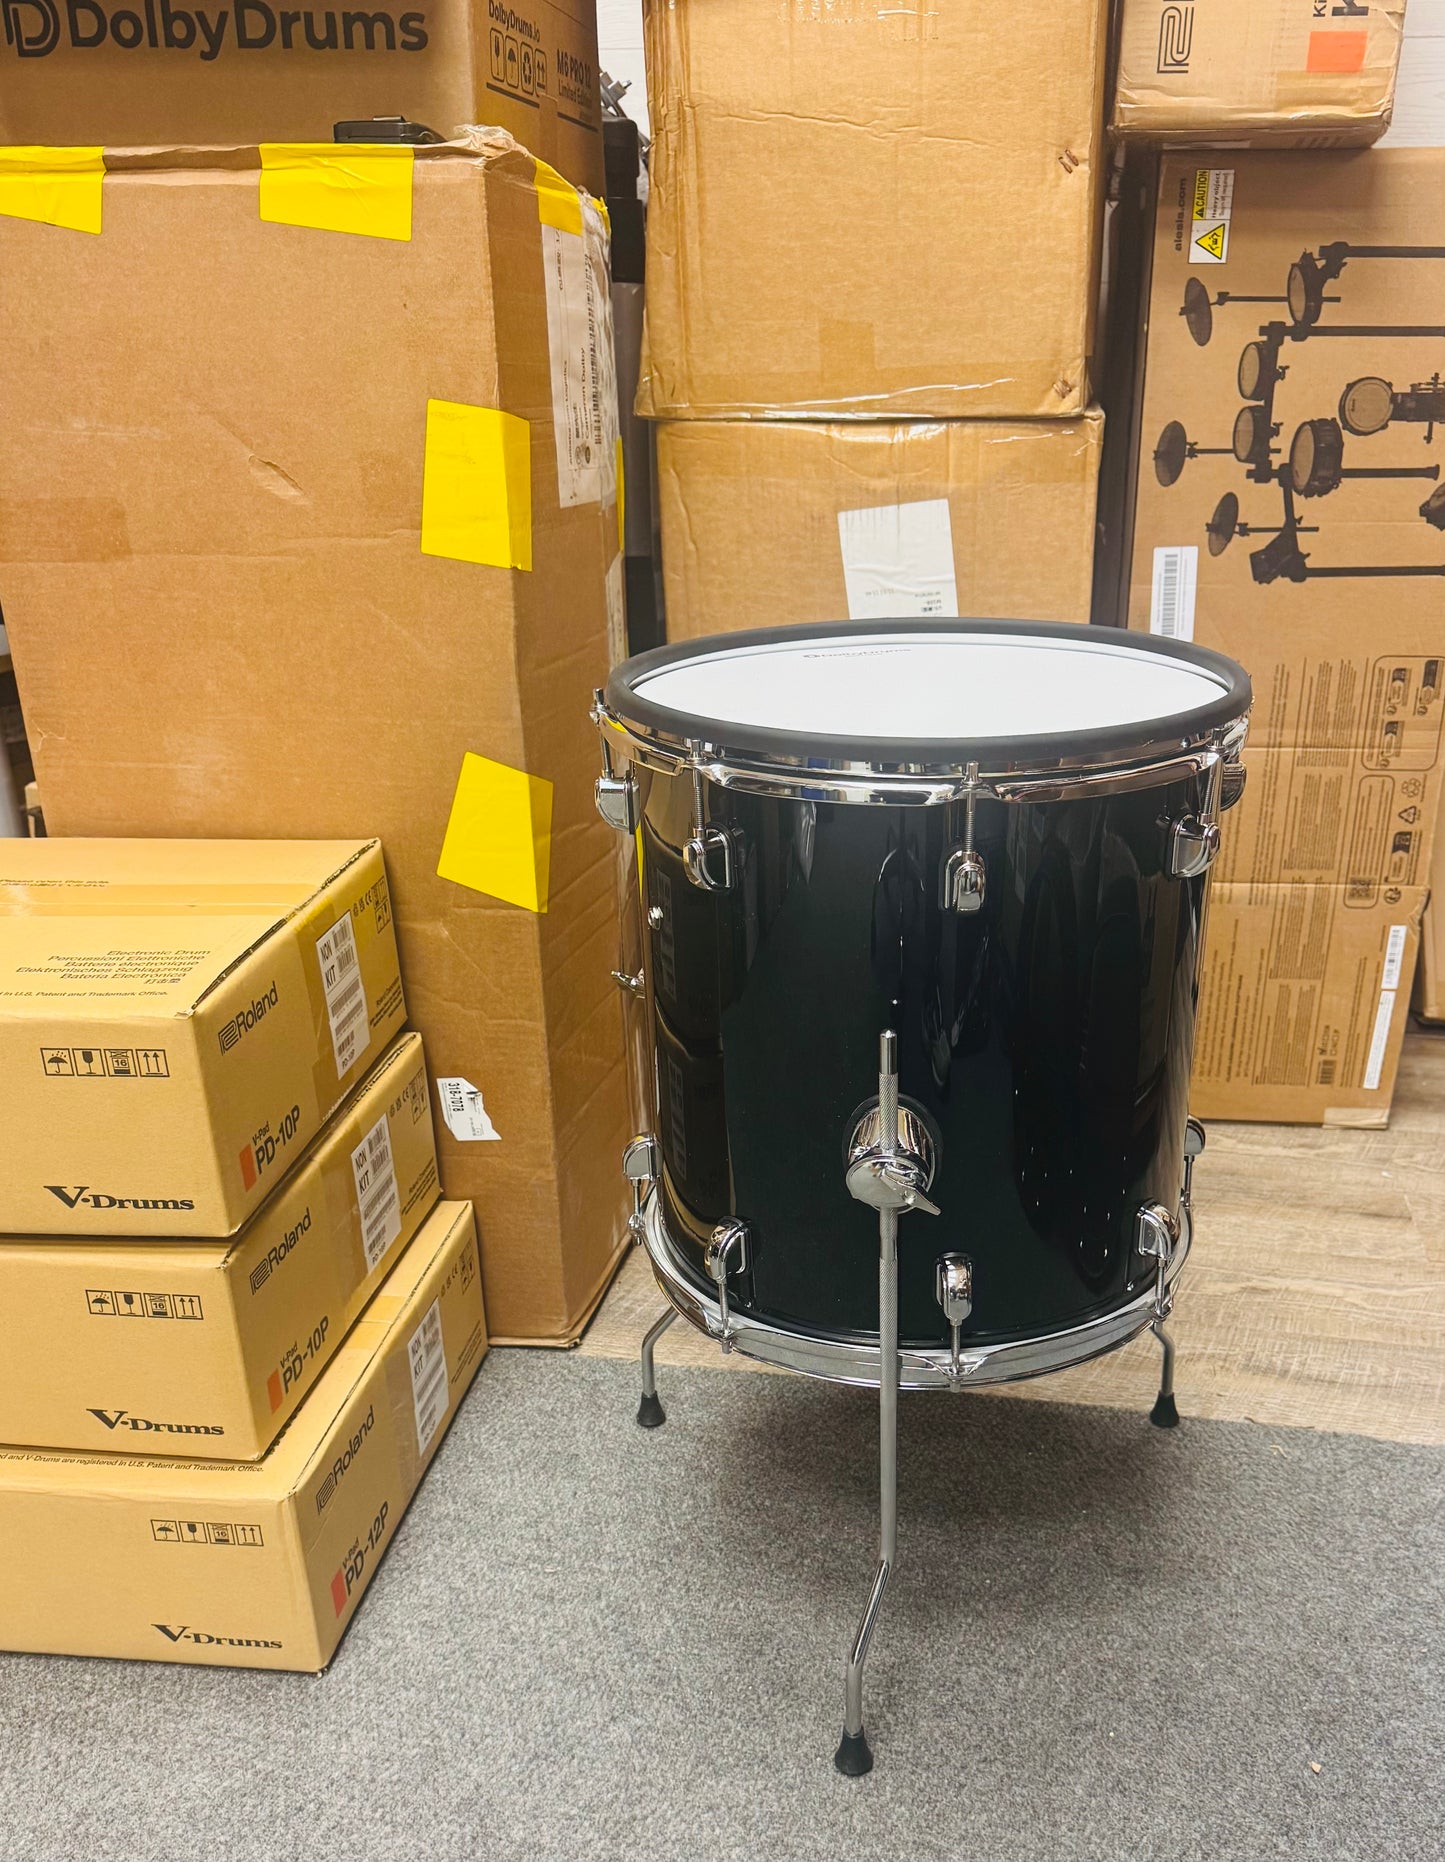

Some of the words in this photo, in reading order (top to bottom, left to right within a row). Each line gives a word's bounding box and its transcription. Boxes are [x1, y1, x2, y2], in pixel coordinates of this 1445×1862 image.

[67, 0, 429, 60] DolbyDrums
[1195, 170, 1208, 207] CAUTION
[1174, 178, 1187, 251] alesis.com
[1212, 194, 1220, 218] Heavy
[324, 964, 337, 990] KIT
[235, 980, 279, 1039] Roland
[115, 1059, 128, 1068] 16
[252, 1120, 270, 1147] V-Pad
[254, 1104, 301, 1175] PD-10P
[355, 1146, 369, 1173] NON
[358, 1170, 371, 1195] KIT
[267, 1207, 312, 1275] Roland
[279, 1341, 298, 1369] V-Pad
[281, 1316, 329, 1395] PD-10P
[413, 1355, 425, 1380] KIT
[332, 1405, 376, 1486] Roland
[26, 1454, 61, 1463] V-Drums
[76, 1458, 119, 1466] registered
[146, 1462, 175, 1470] Patent
[193, 1464, 236, 1472] Trademark
[215, 1529, 228, 1538] 16
[345, 1501, 390, 1596] PD-12P
[341, 1535, 360, 1569] V-Pad
